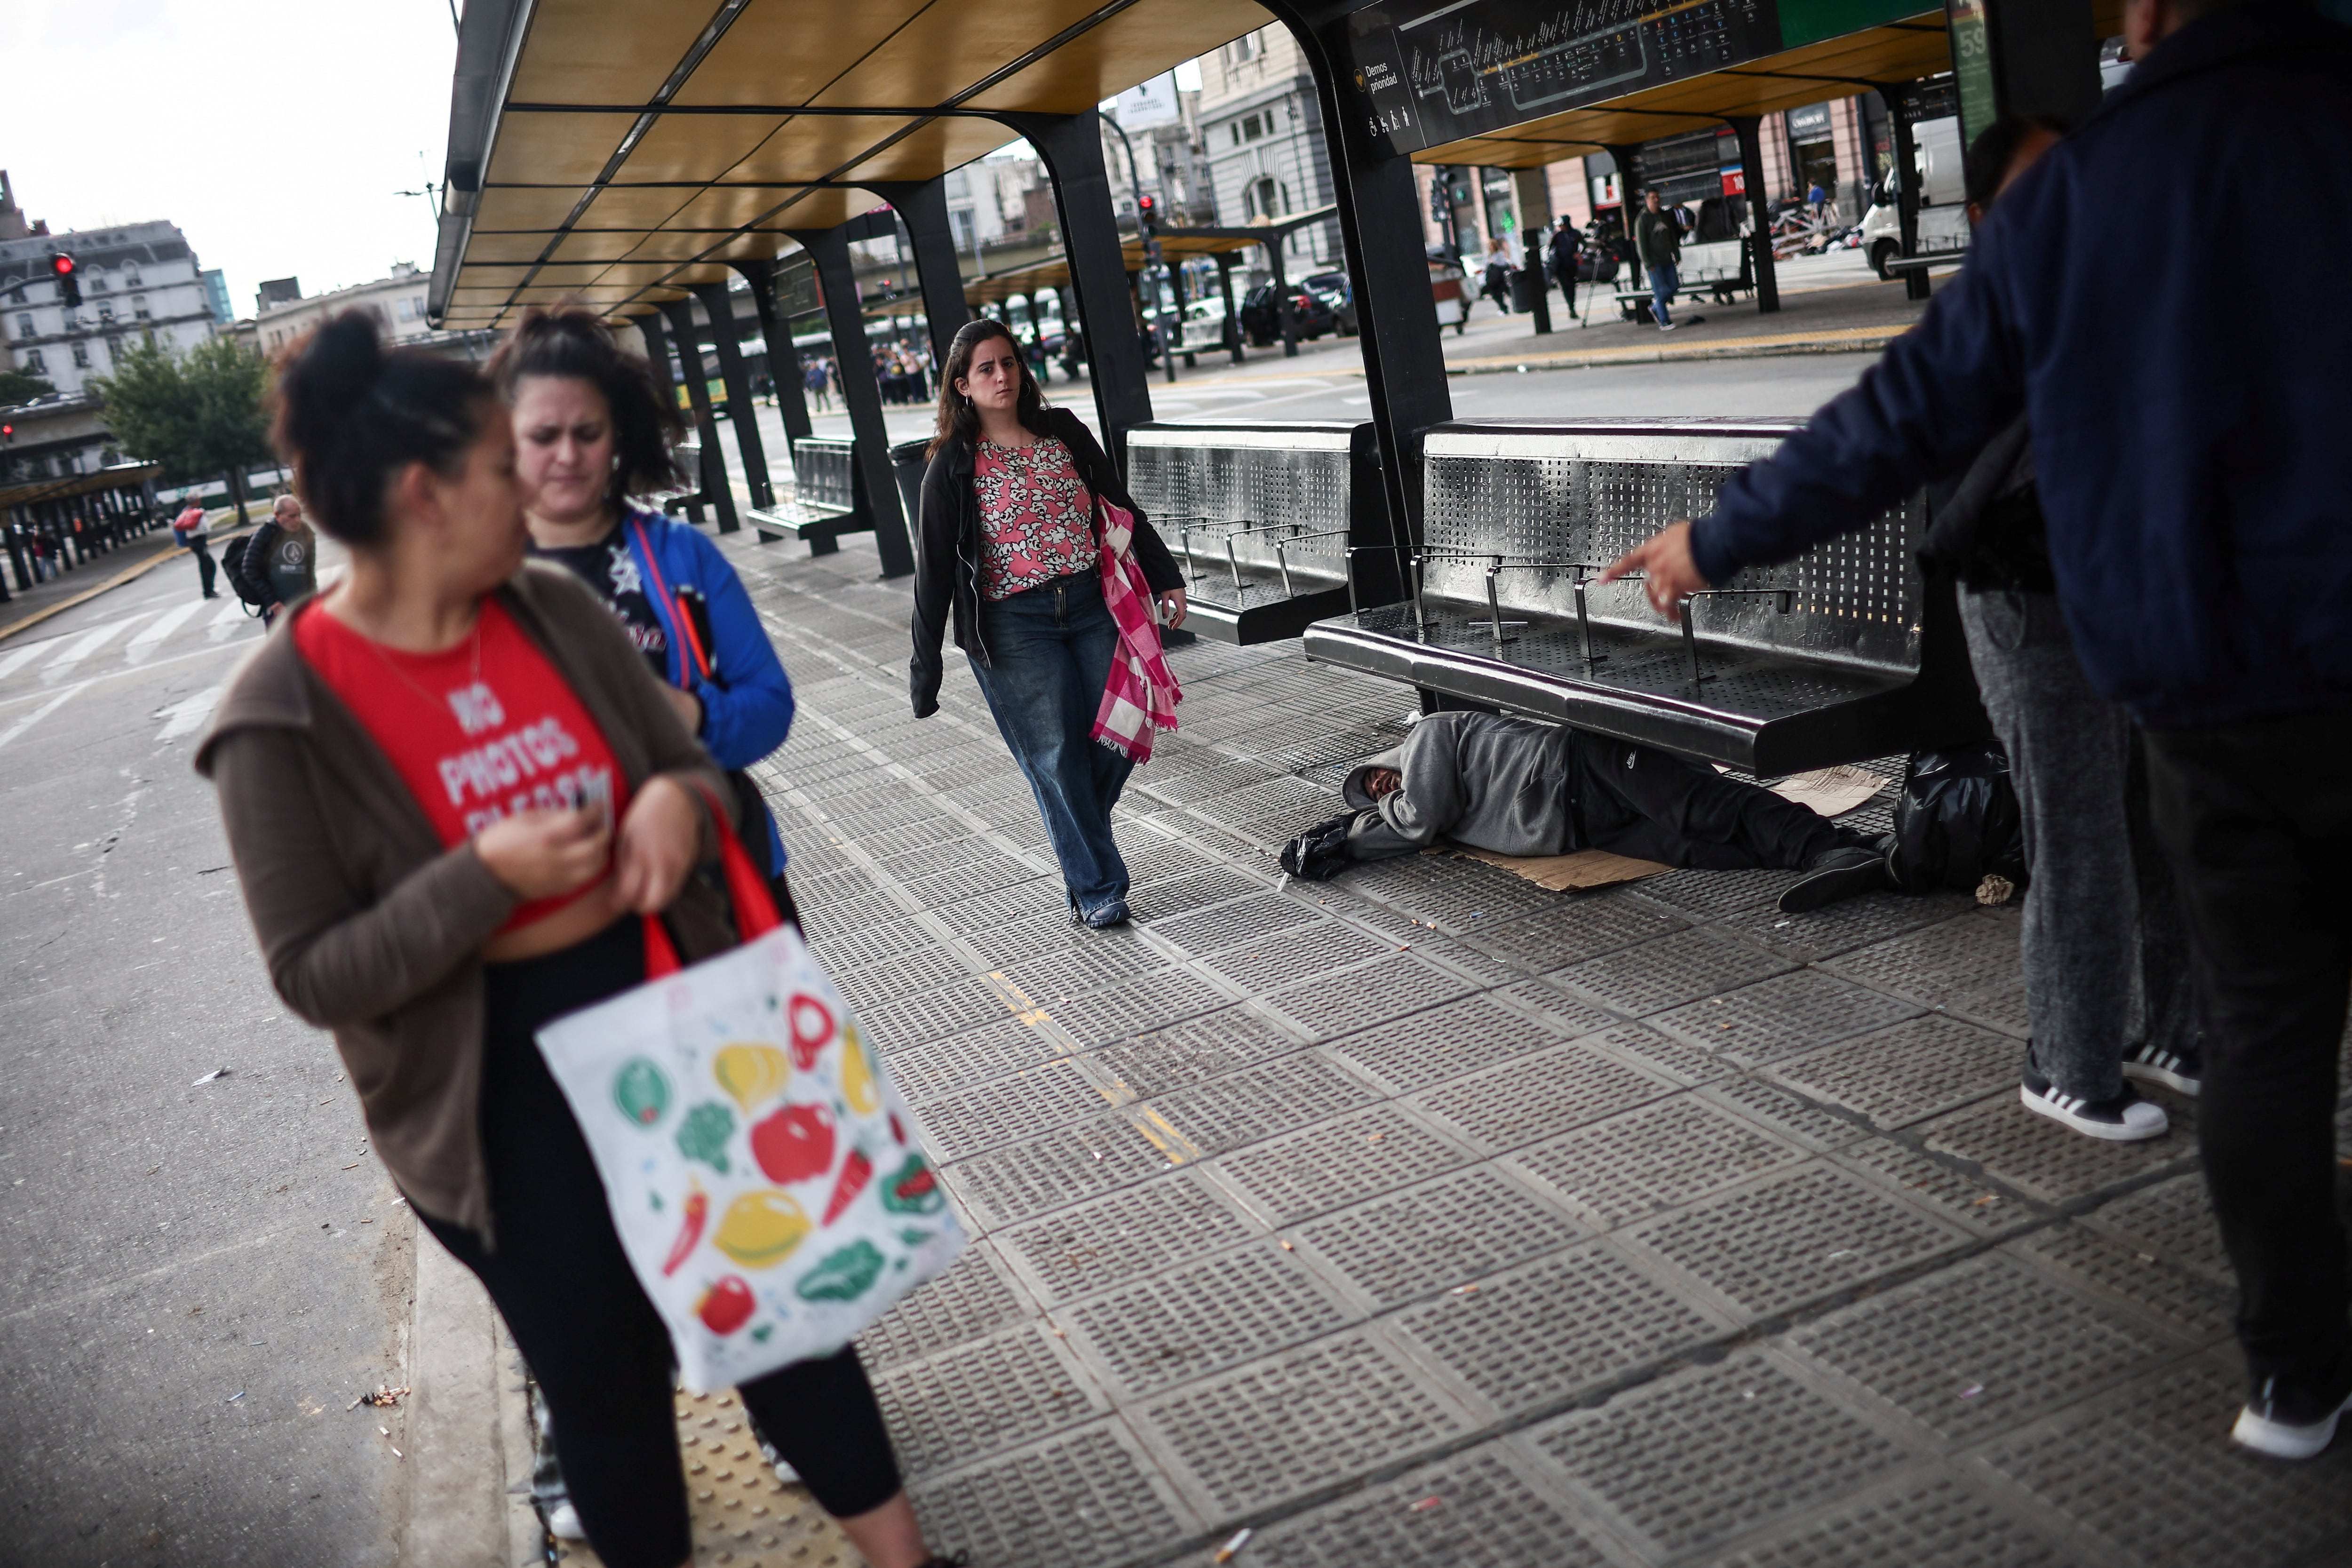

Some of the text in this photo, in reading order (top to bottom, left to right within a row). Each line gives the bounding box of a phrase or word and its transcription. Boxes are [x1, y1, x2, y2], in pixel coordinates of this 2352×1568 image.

[1959, 27, 1986, 57] 59
[1365, 63, 1388, 77] Demos
[1370, 72, 1398, 95] prioridad
[446, 682, 505, 736] NO
[437, 716, 580, 806] PHOTOS
